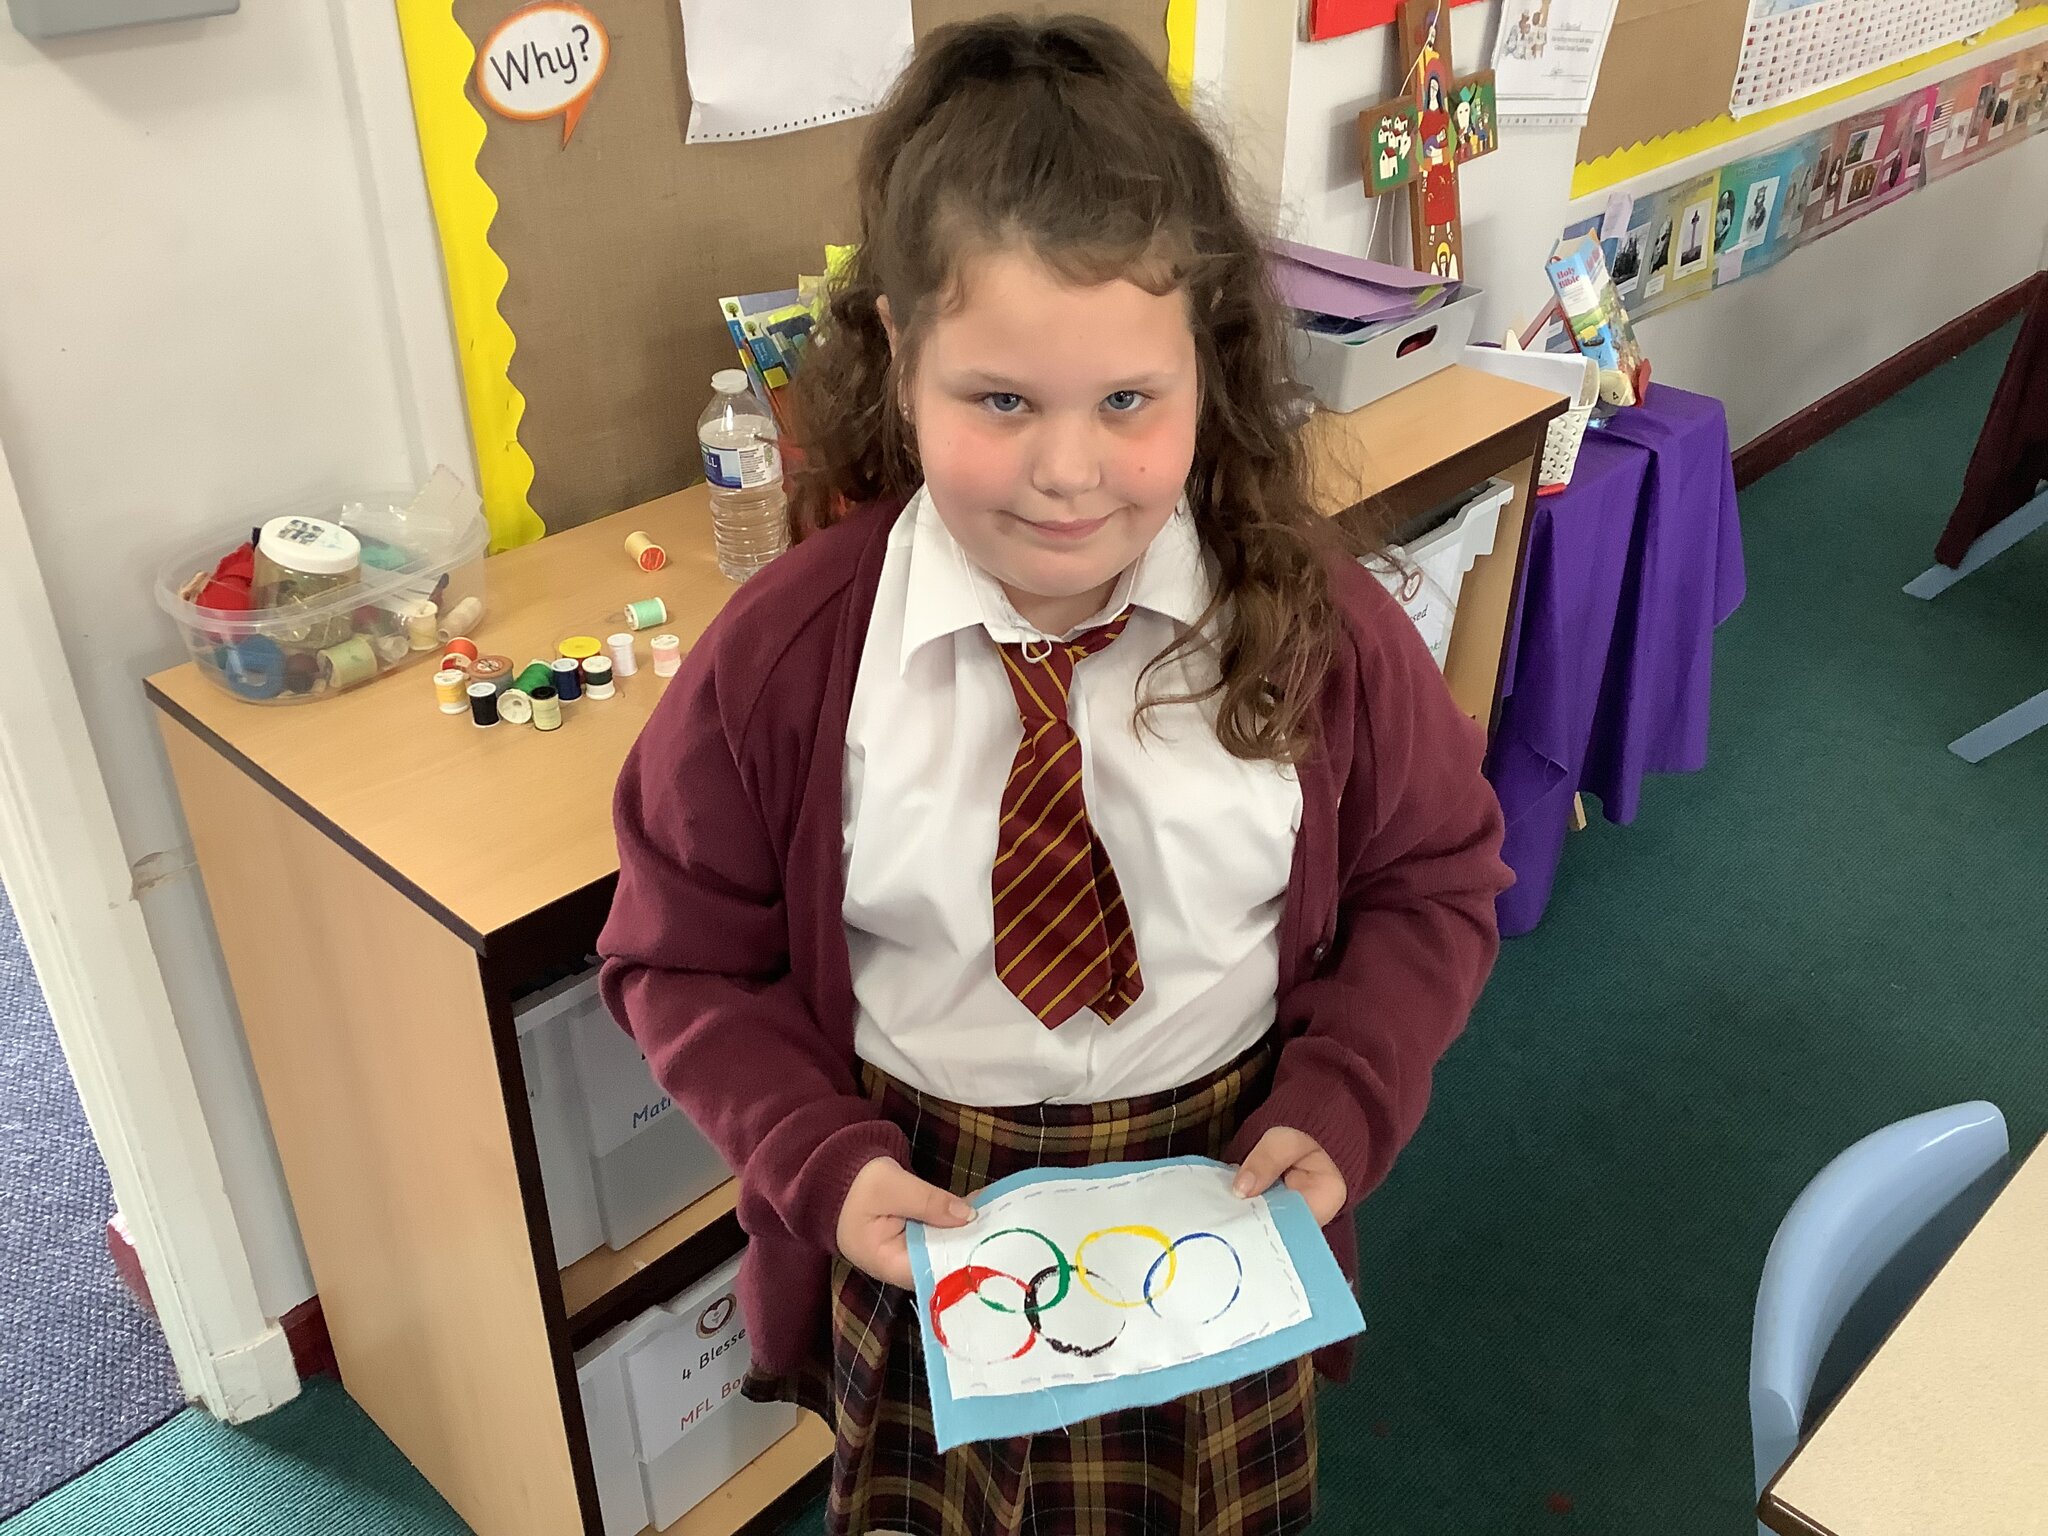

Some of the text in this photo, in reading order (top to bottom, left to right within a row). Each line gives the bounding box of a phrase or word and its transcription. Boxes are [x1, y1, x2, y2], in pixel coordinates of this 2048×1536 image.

[490, 24, 589, 91] Why?
[1556, 267, 1576, 279] Holy
[1558, 275, 1581, 289] Bible
[1412, 603, 1429, 622] sed
[682, 1328, 747, 1380] 4 Blesse
[680, 1397, 714, 1431] MFL
